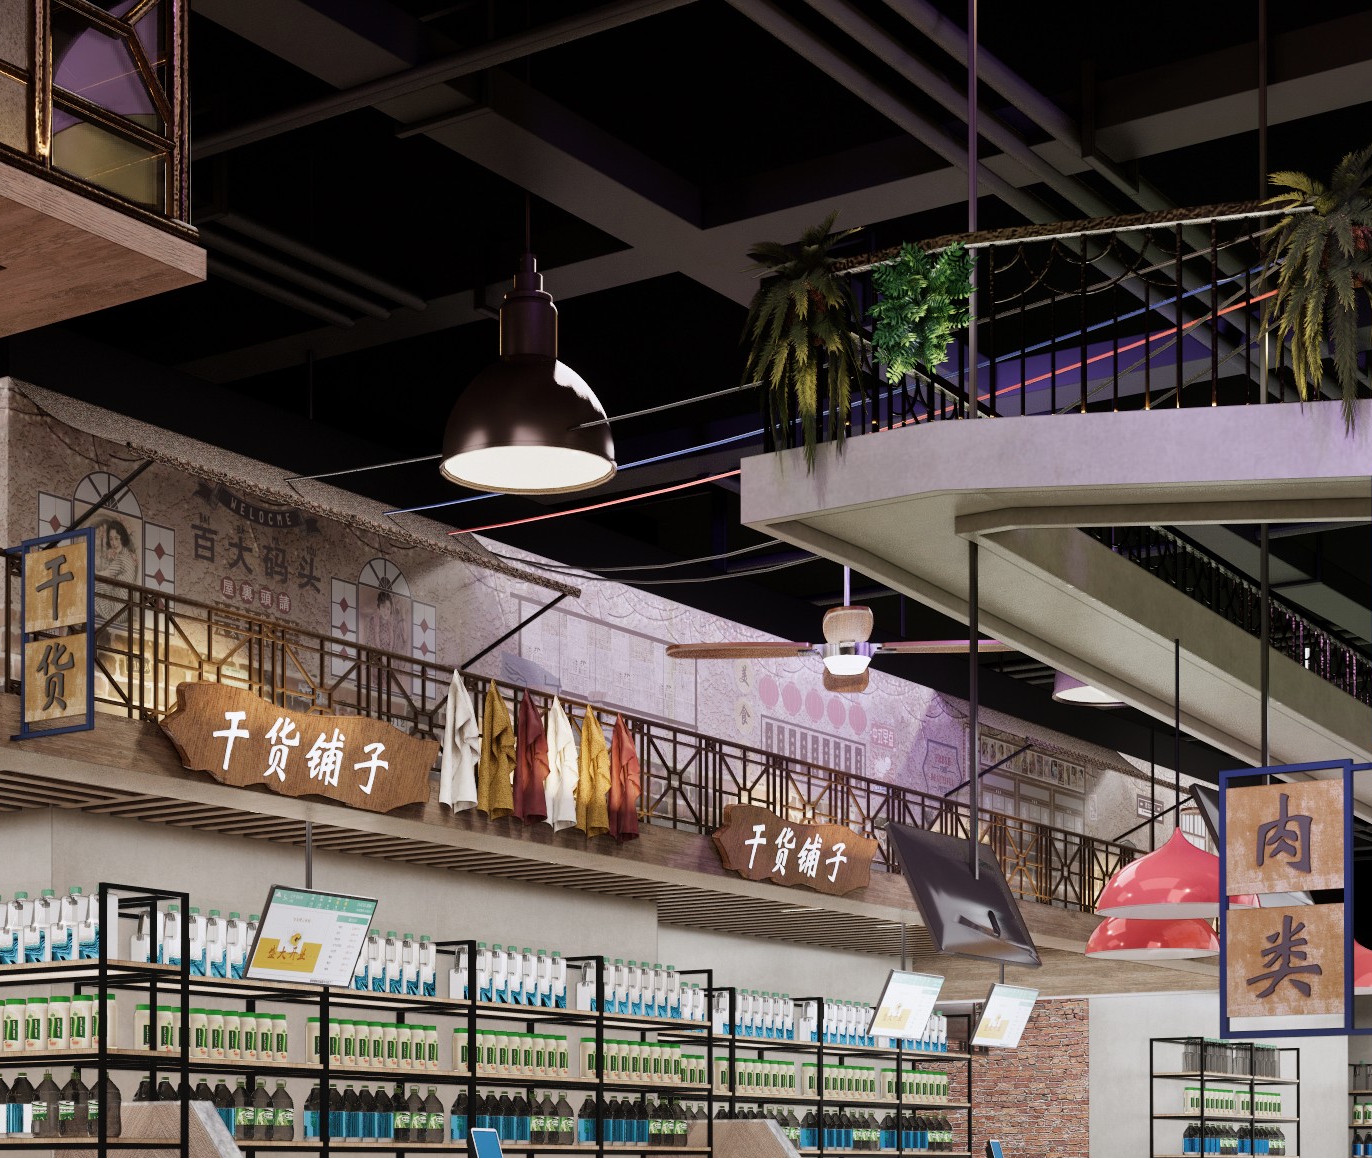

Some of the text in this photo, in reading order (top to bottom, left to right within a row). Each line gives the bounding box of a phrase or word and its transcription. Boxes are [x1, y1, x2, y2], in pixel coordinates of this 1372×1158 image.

[190, 523, 321, 594] 百大码头
[36, 554, 75, 712] 干货
[211, 710, 389, 795] 干货铺子
[744, 823, 848, 883] 干货铺子
[1247, 793, 1323, 1000] 肉类
